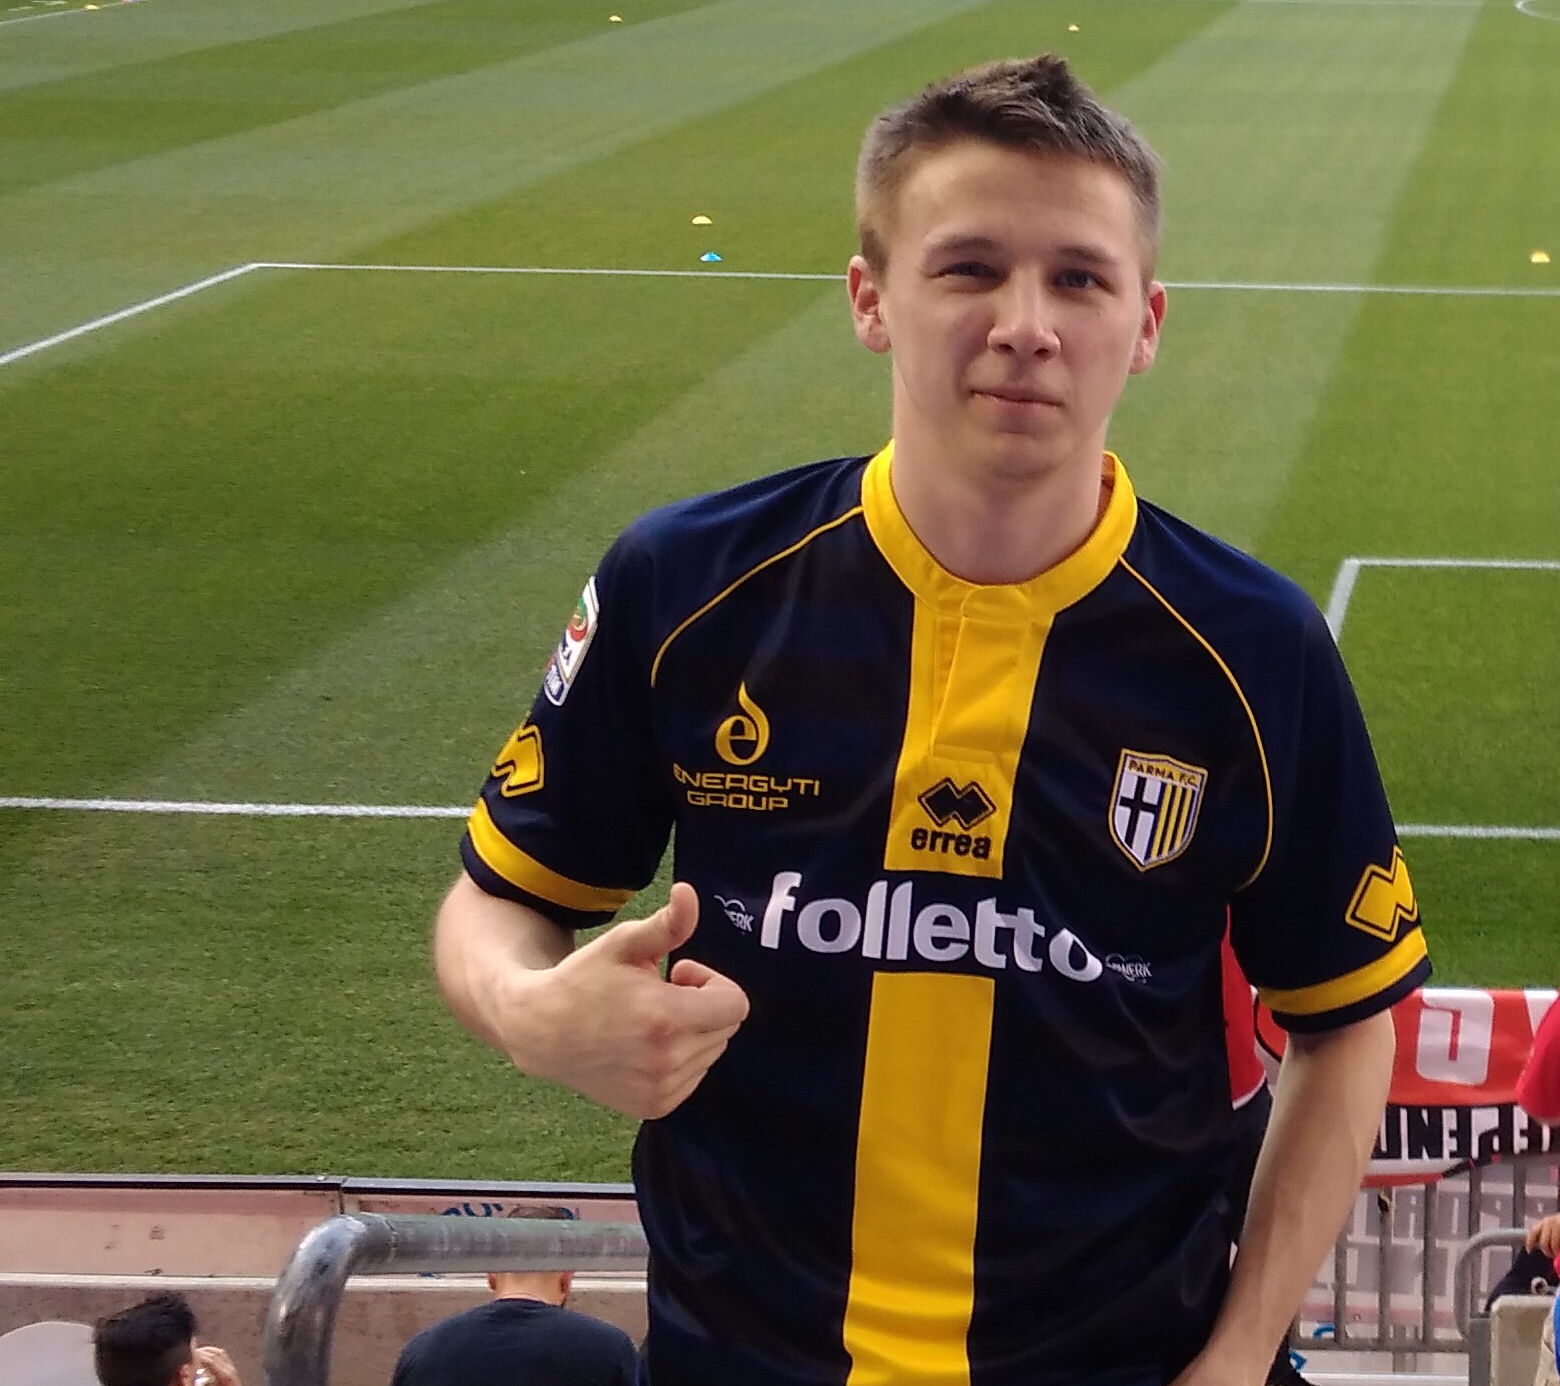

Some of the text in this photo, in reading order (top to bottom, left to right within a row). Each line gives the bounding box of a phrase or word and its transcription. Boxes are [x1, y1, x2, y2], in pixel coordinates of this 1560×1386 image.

[1129, 759, 1175, 781] PARMA
[687, 789, 789, 811] GROUP
[760, 870, 1103, 983] folletto
